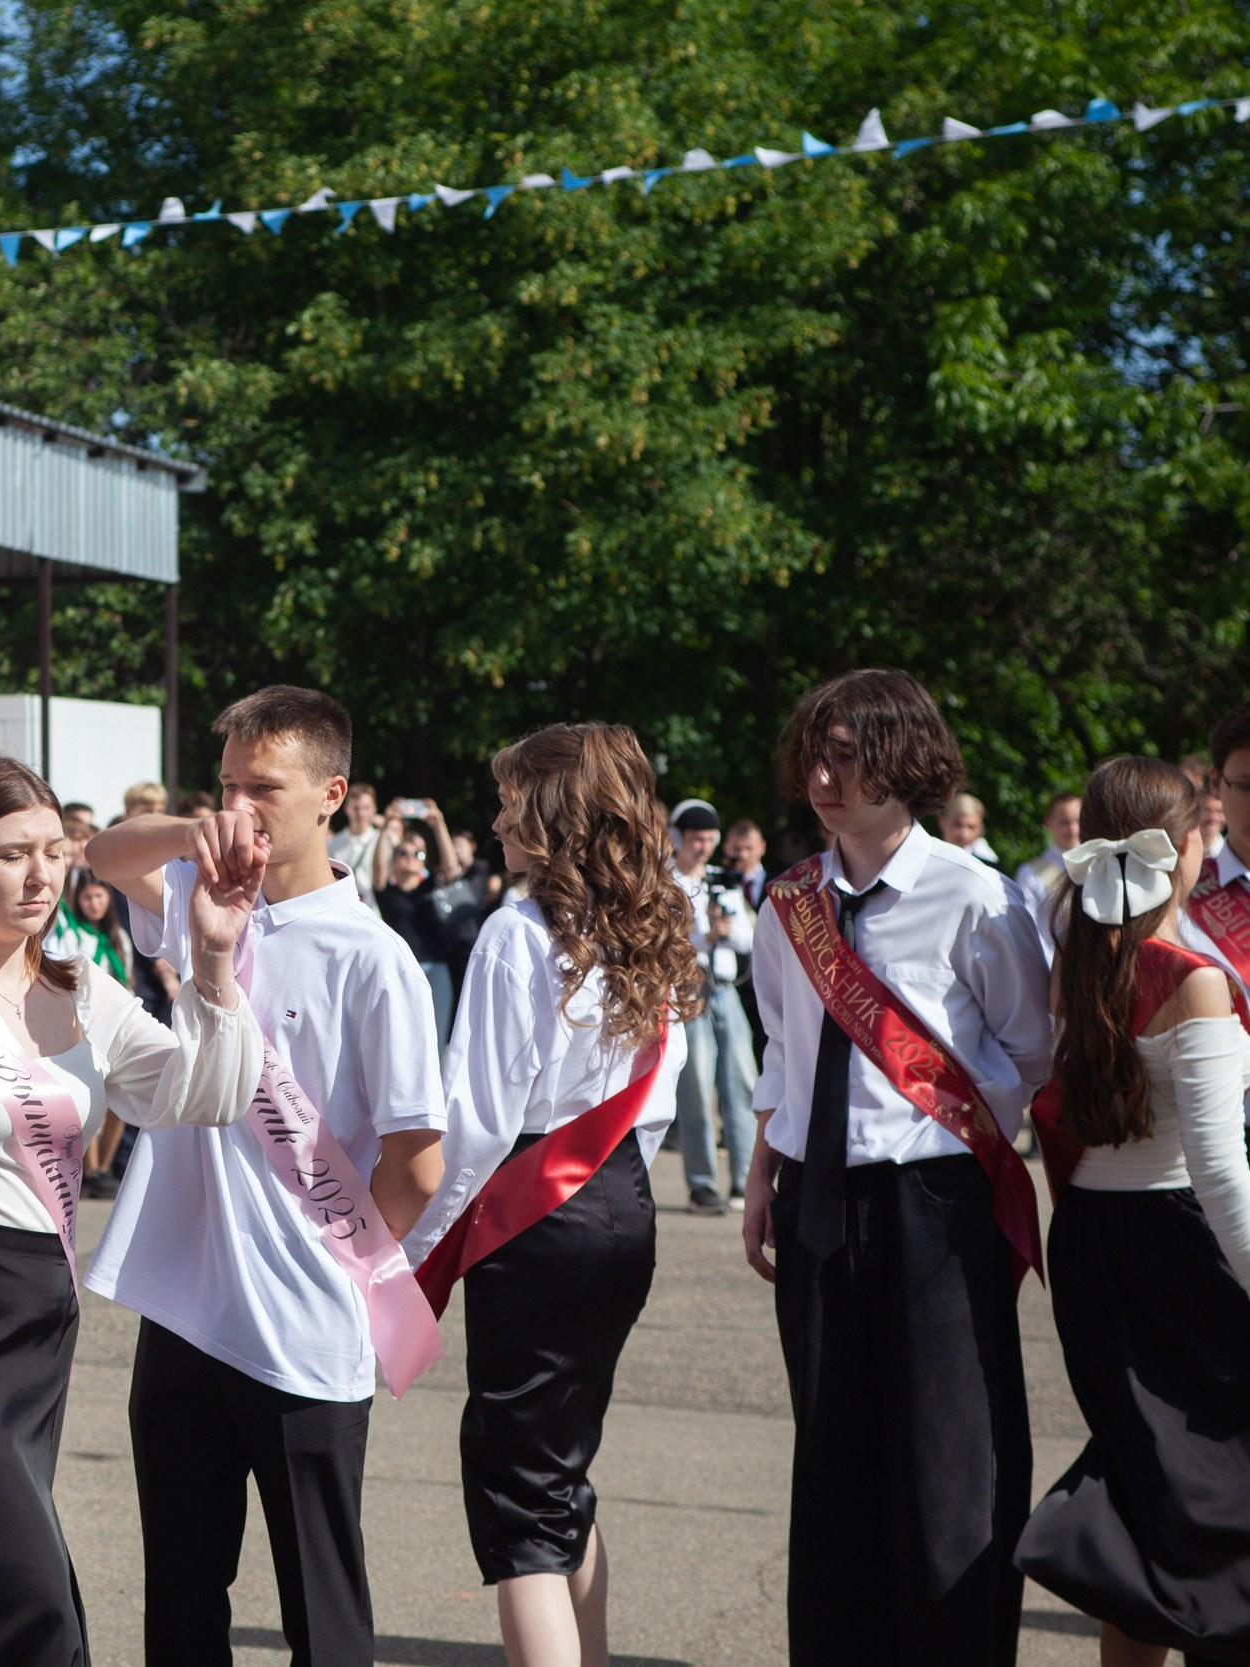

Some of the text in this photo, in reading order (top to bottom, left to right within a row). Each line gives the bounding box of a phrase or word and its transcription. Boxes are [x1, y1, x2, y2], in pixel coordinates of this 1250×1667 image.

[1206, 890, 1250, 949] ВЫП
[795, 892, 945, 1085] ВЫПУСКНИК 2025
[812, 969, 834, 1000] МАОУ
[831, 999, 855, 1026] СОШ
[851, 1022, 873, 1047] №10
[291, 1158, 367, 1240] 2025
